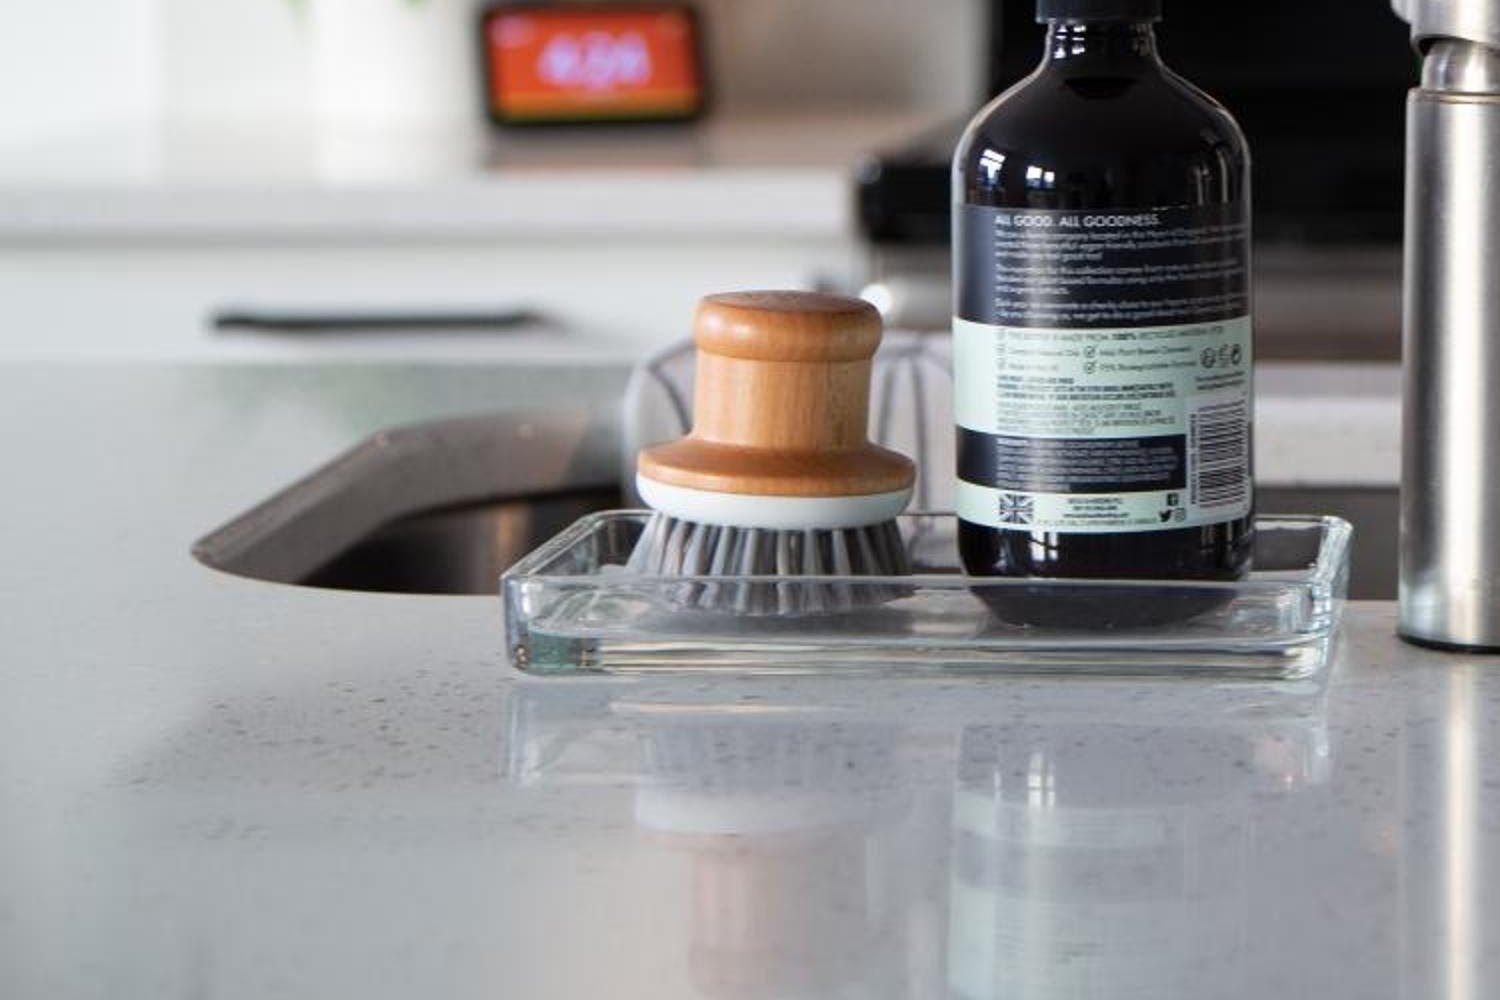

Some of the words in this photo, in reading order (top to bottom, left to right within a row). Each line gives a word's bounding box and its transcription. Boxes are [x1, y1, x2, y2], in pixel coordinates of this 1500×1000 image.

[995, 214, 1011, 226] ALL
[1013, 215, 1055, 227] GOOD.
[1059, 215, 1080, 227] ALL
[1083, 213, 1161, 228] GOODNESS.
